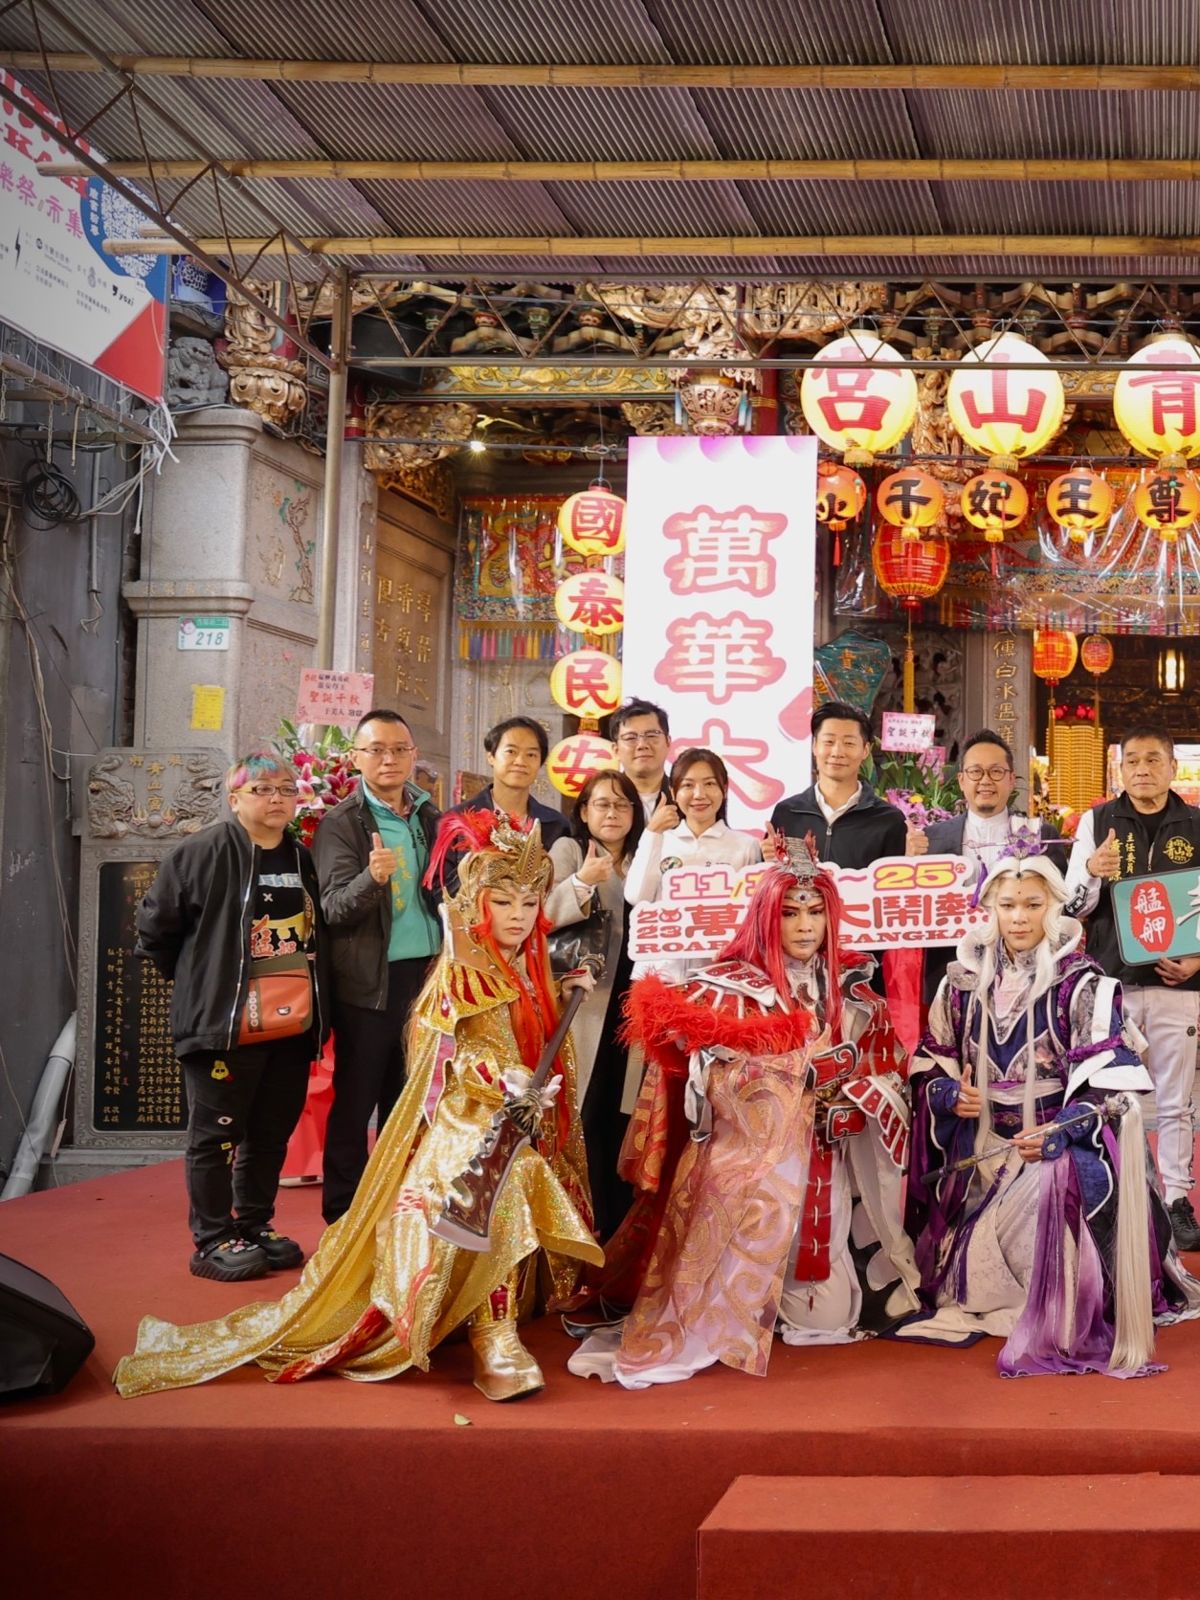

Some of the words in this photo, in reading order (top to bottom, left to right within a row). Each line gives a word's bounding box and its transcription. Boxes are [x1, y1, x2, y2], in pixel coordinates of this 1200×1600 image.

[959, 352, 1047, 433] 山
[885, 478, 932, 520] 千
[968, 479, 1019, 522] 妃
[1056, 477, 1099, 519] 王
[1146, 475, 1192, 523] 尊
[571, 495, 626, 547] 國
[567, 576, 624, 628] 泰
[195, 632, 224, 646] 218
[565, 658, 622, 711] 民
[1125, 832, 1137, 875] 主任委員
[637, 925, 682, 940] 23
[1134, 888, 1167, 944] 艋舺
[248, 990, 259, 1028] GOODS
